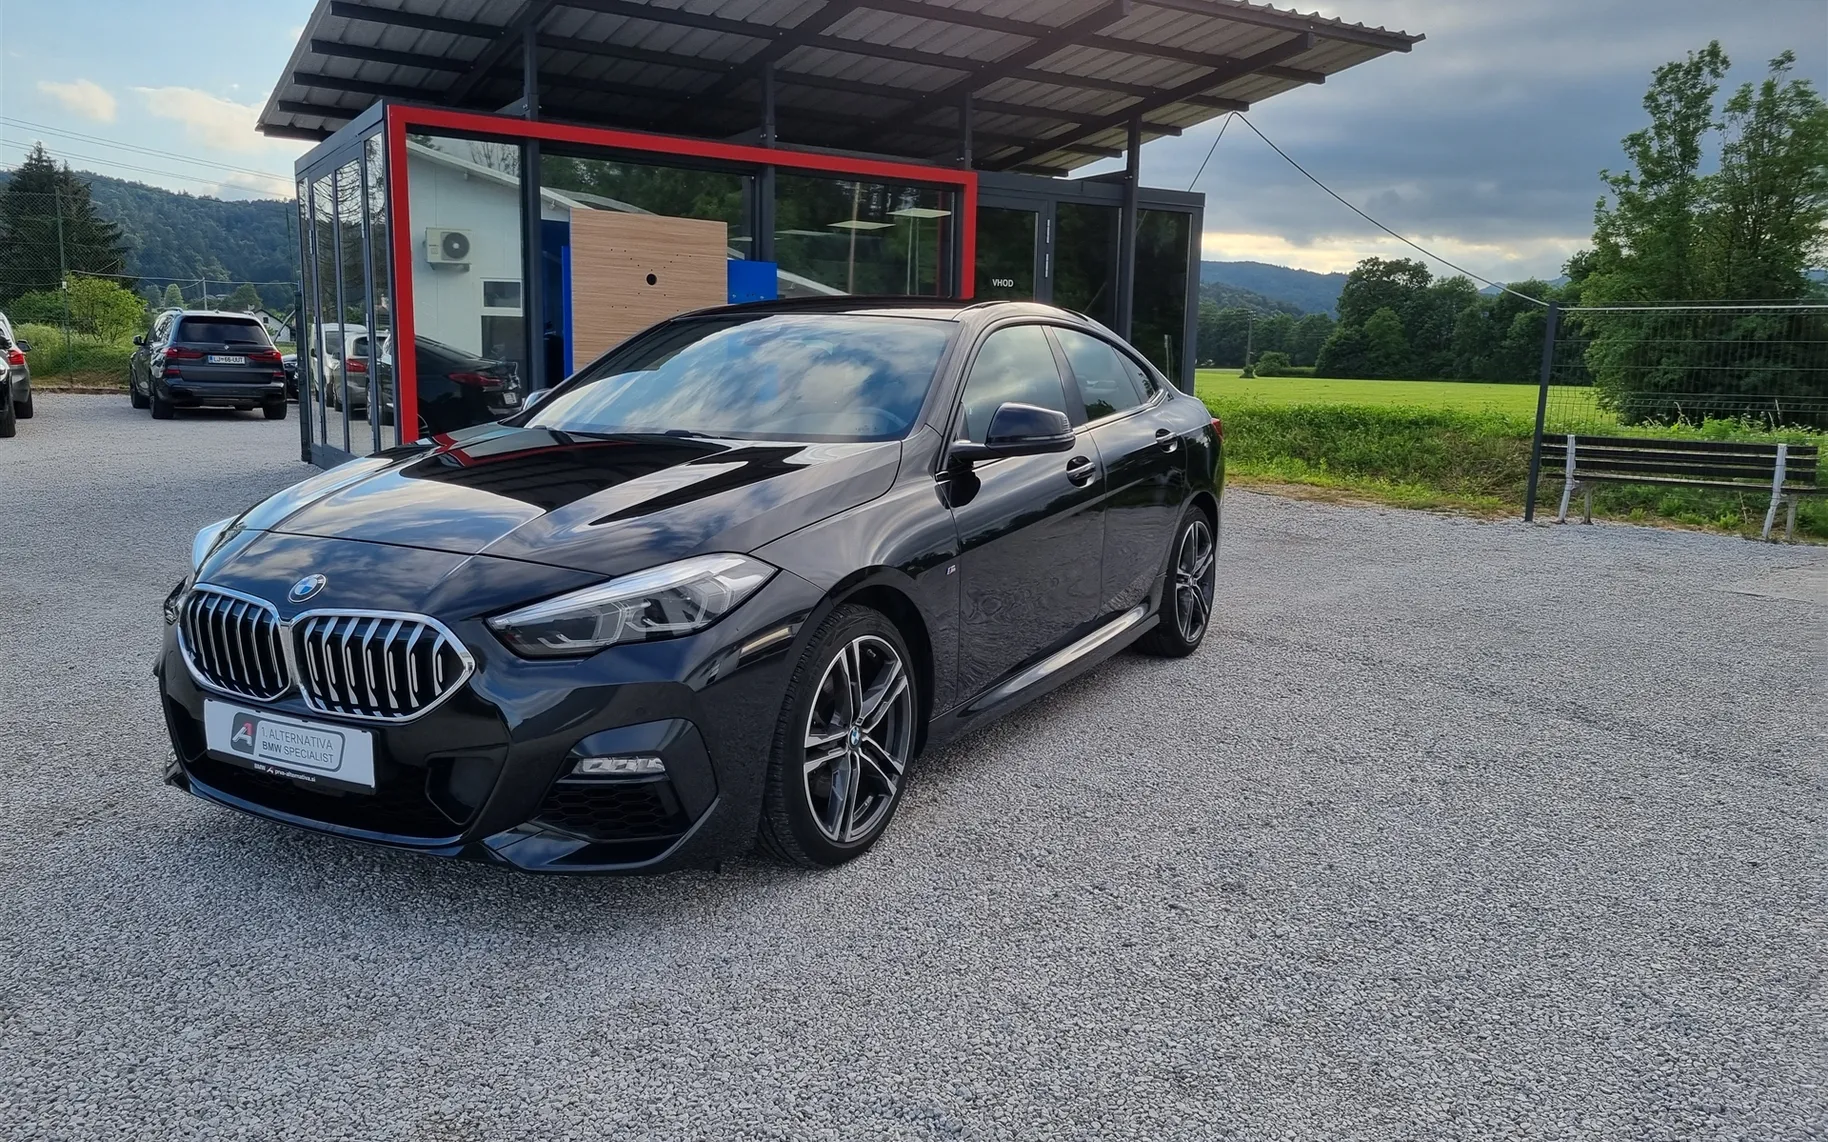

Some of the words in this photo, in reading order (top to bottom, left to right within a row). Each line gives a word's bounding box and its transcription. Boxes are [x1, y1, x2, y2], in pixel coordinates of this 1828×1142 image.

[992, 279, 1014, 287] VHOD
[262, 727, 268, 737] 1.
[269, 728, 333, 750] ALTERNATIVA
[262, 740, 282, 754] BMW
[283, 745, 334, 763] SPECIALIST
